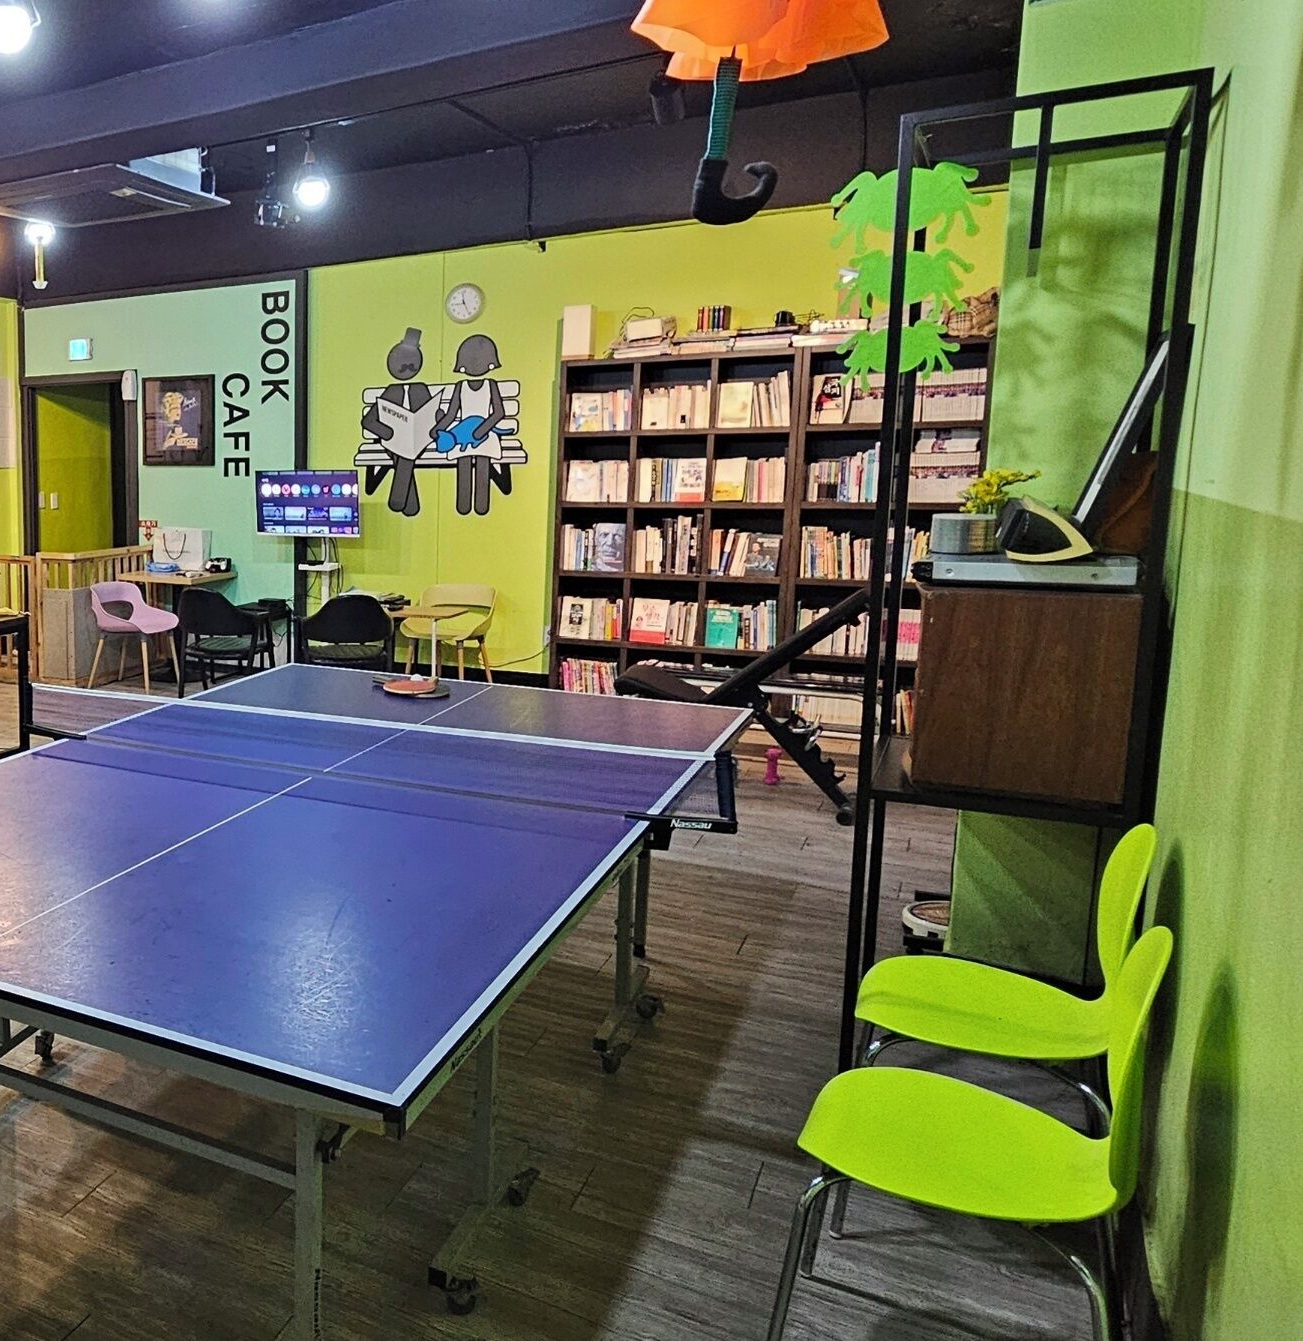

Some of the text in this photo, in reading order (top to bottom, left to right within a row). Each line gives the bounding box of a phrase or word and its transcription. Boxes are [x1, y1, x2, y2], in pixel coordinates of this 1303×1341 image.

[261, 291, 290, 404] BOOK
[222, 373, 250, 477] CAFE
[670, 818, 712, 830] Nassau
